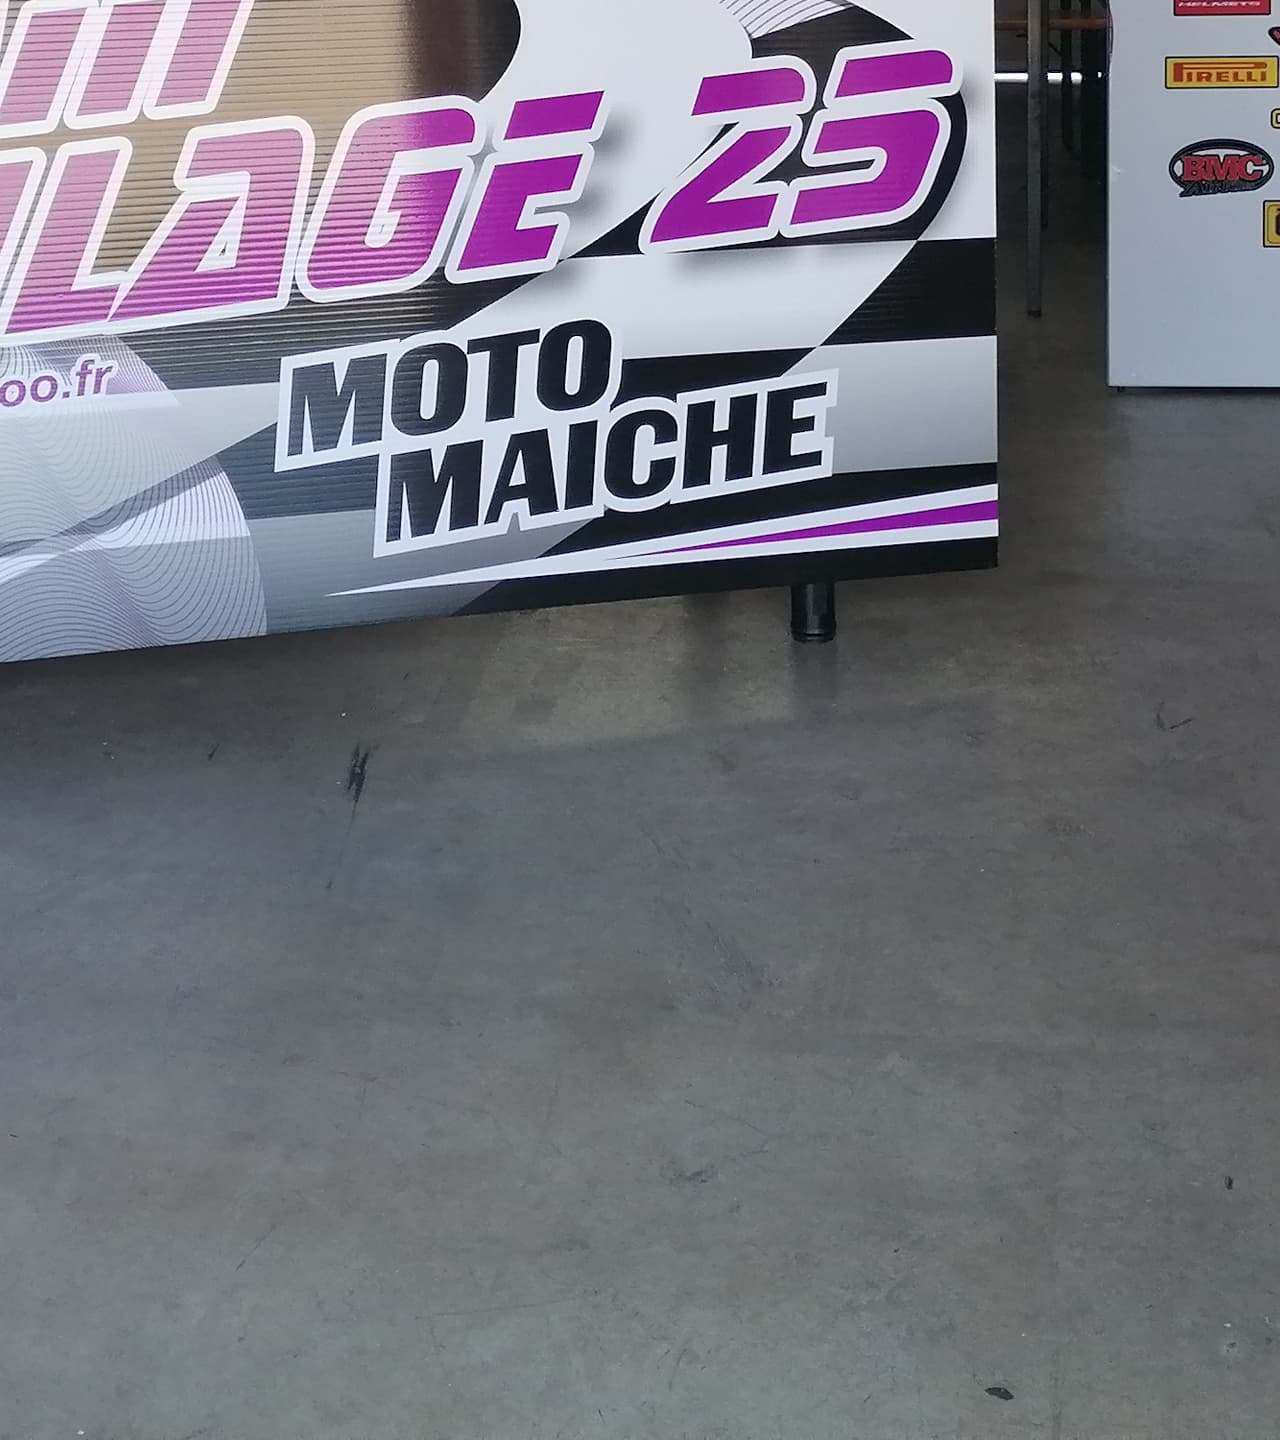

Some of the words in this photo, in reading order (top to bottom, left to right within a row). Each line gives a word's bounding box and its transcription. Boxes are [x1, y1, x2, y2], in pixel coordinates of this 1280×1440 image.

[1172, 61, 1268, 83] PIRELLI
[641, 42, 962, 253] 25
[1182, 154, 1264, 182] BMC
[286, 319, 613, 459] MOTO
[384, 379, 828, 545] MAICHE
